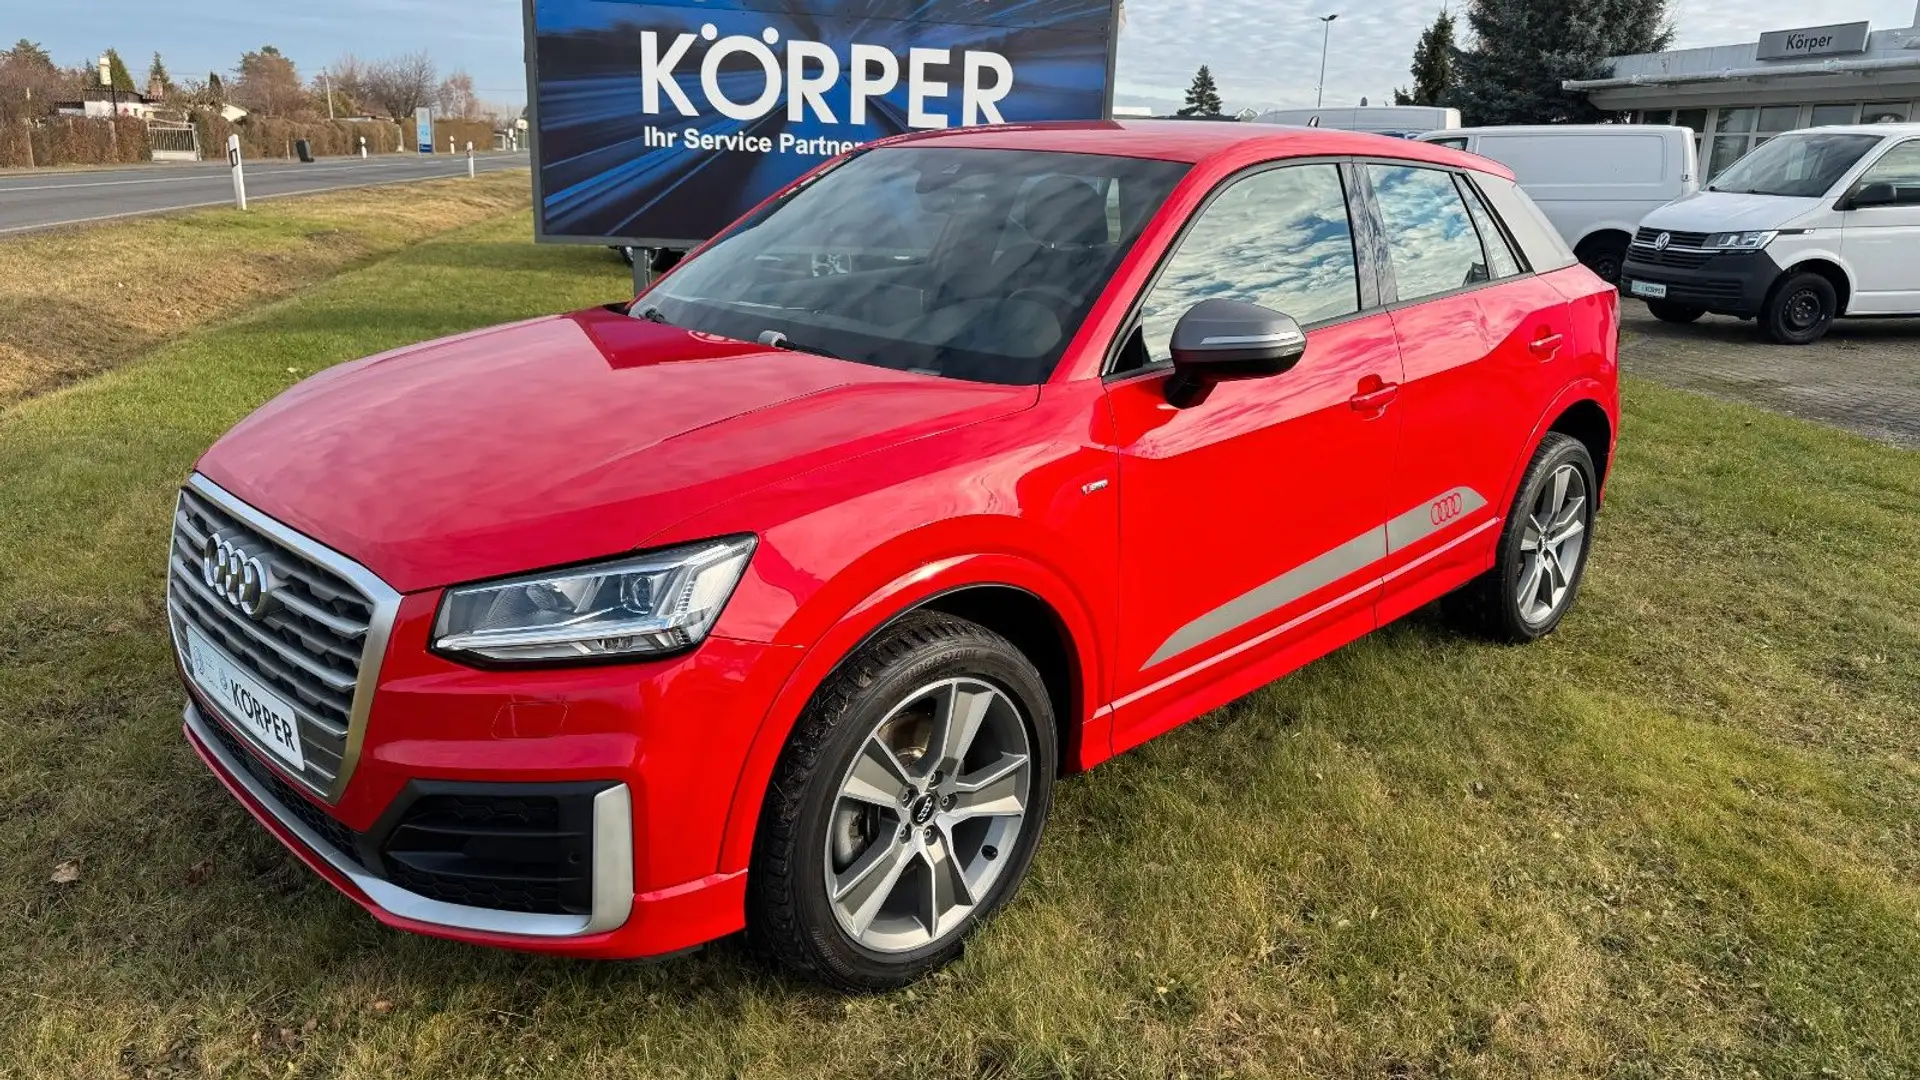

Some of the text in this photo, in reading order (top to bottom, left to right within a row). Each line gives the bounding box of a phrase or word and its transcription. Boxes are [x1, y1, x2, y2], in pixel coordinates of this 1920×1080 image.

[1785, 33, 1833, 52] Körper
[640, 23, 1014, 128] KÖRPER
[644, 126, 677, 148] Ihr
[684, 127, 772, 153] Service
[230, 679, 296, 752] KÖRPER
